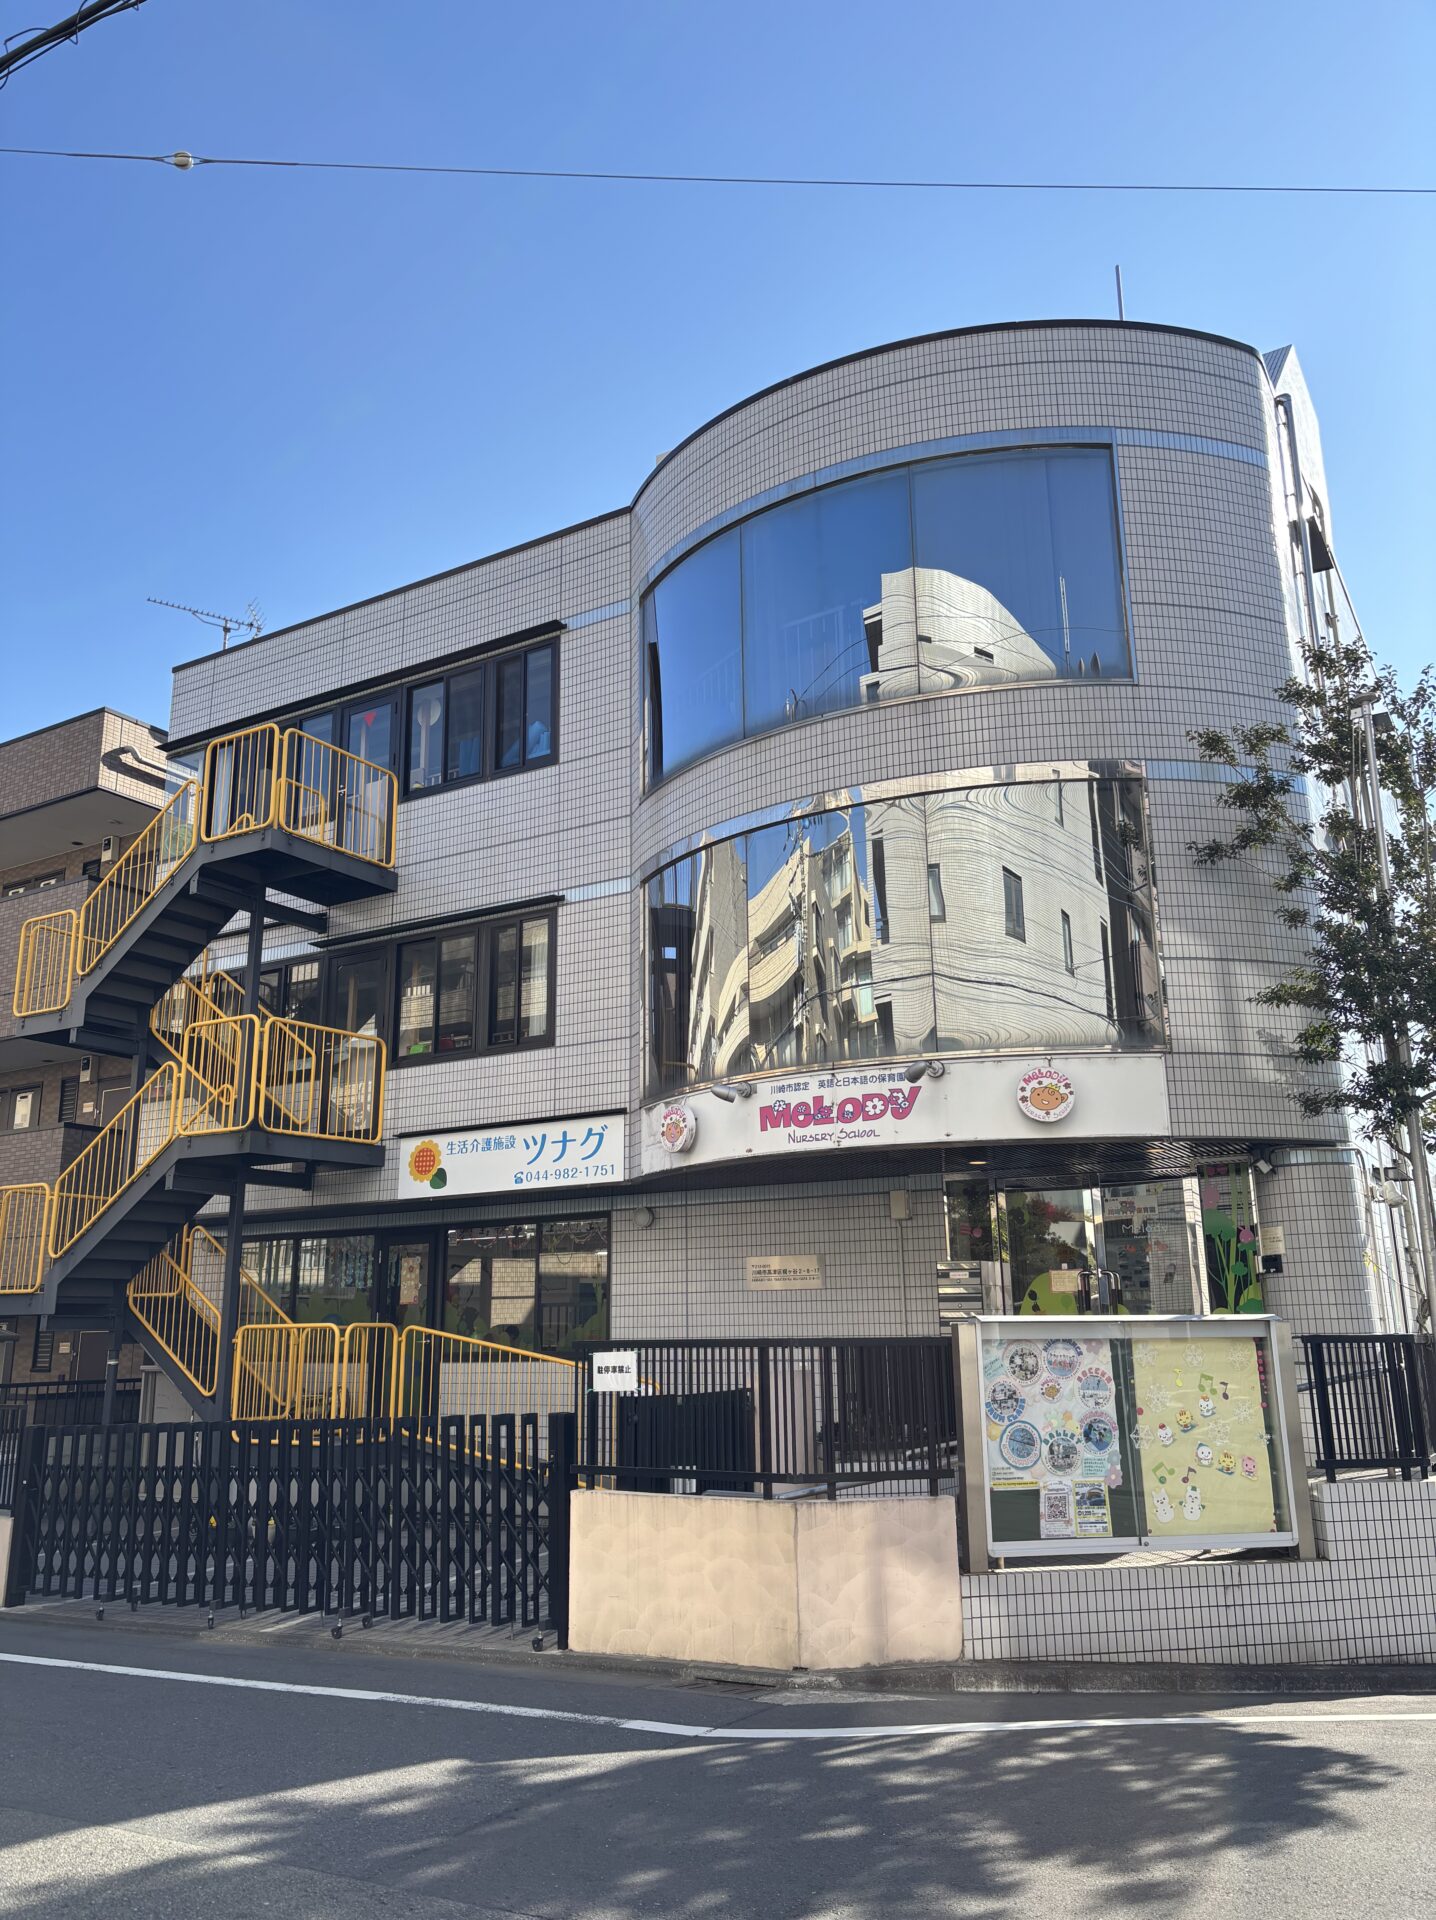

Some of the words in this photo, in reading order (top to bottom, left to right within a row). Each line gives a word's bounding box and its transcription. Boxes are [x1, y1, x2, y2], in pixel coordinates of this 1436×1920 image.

[770, 1081, 810, 1095] 川崎市認定
[817, 1071, 906, 1089] 英語と日本語の保育園
[446, 1134, 516, 1156] 生活介護施設
[523, 1124, 608, 1166] ツナグ
[525, 1164, 615, 1183] 044-982-1751
[597, 1365, 632, 1375] 駐停車禁止
